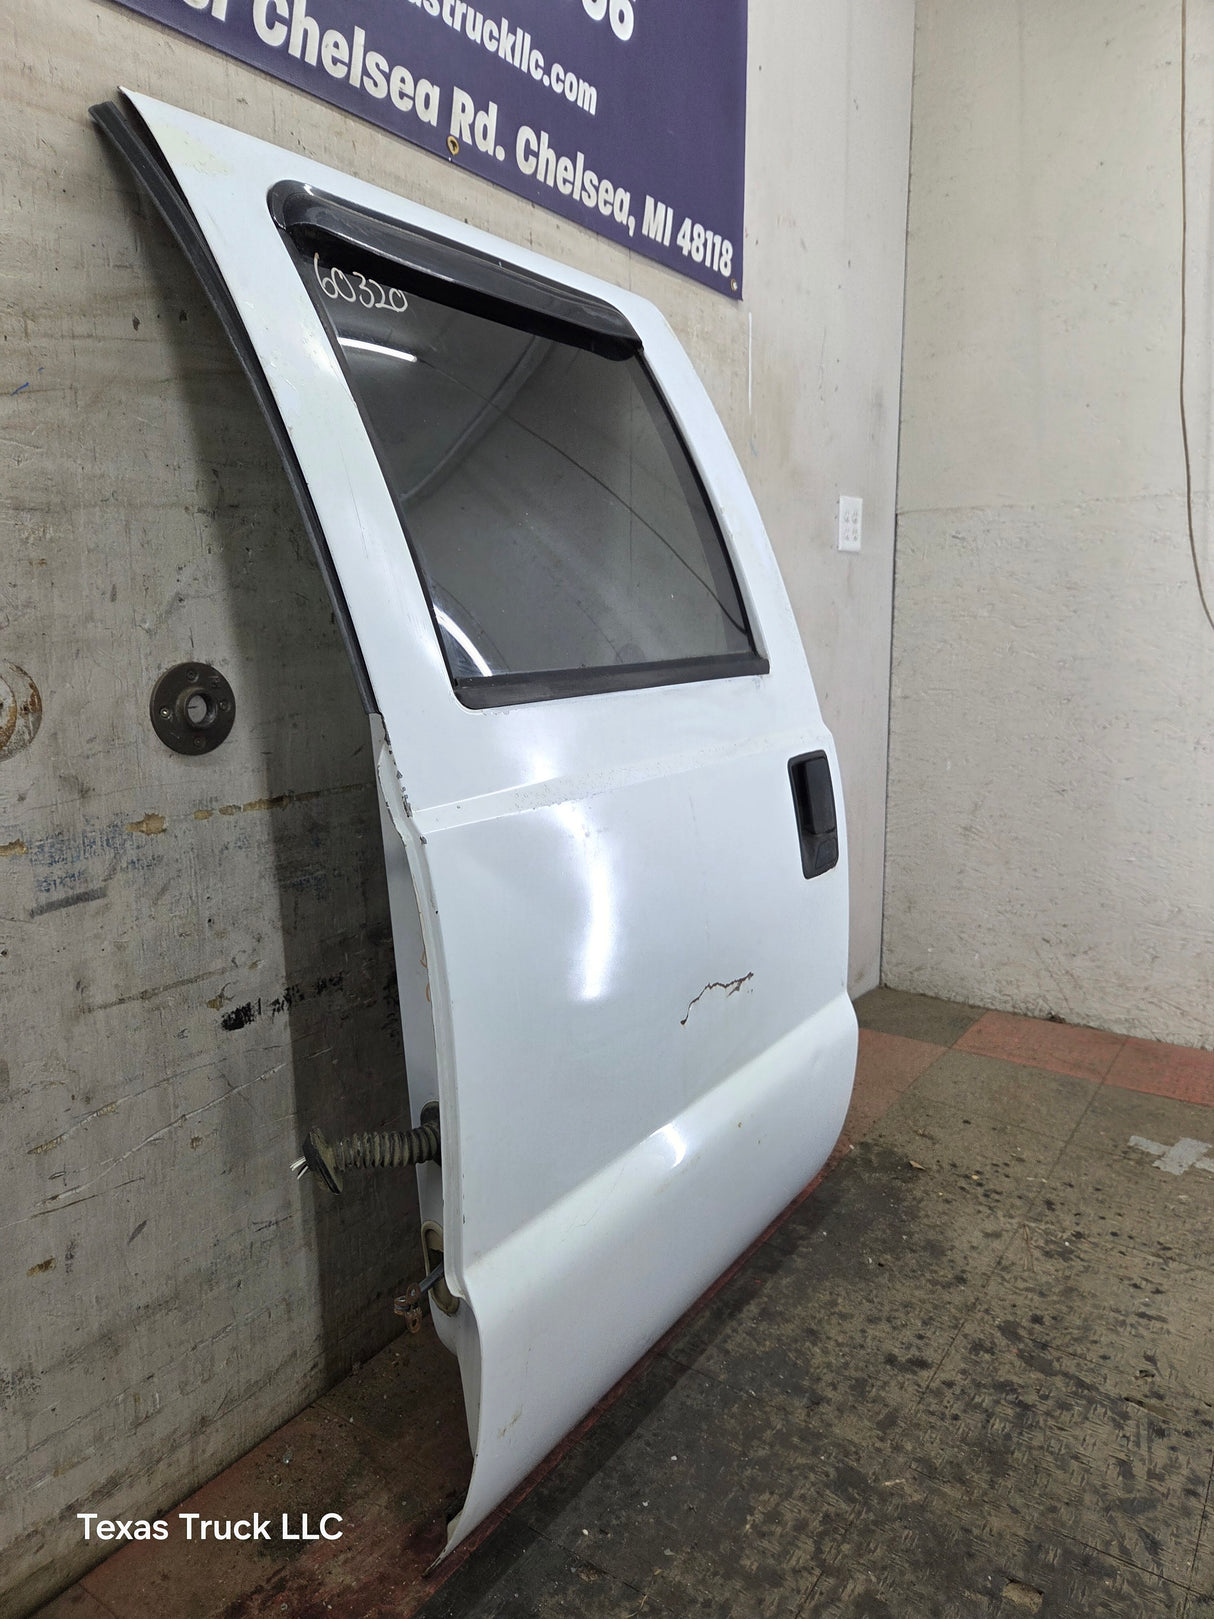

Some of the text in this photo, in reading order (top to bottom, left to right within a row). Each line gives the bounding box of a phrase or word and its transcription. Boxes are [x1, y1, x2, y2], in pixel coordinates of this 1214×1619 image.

[407, 0, 598, 116] struckllc.com
[252, 0, 733, 277] Chelsea Rd. Chelsea, MI 48118
[313, 252, 408, 312] 60320
